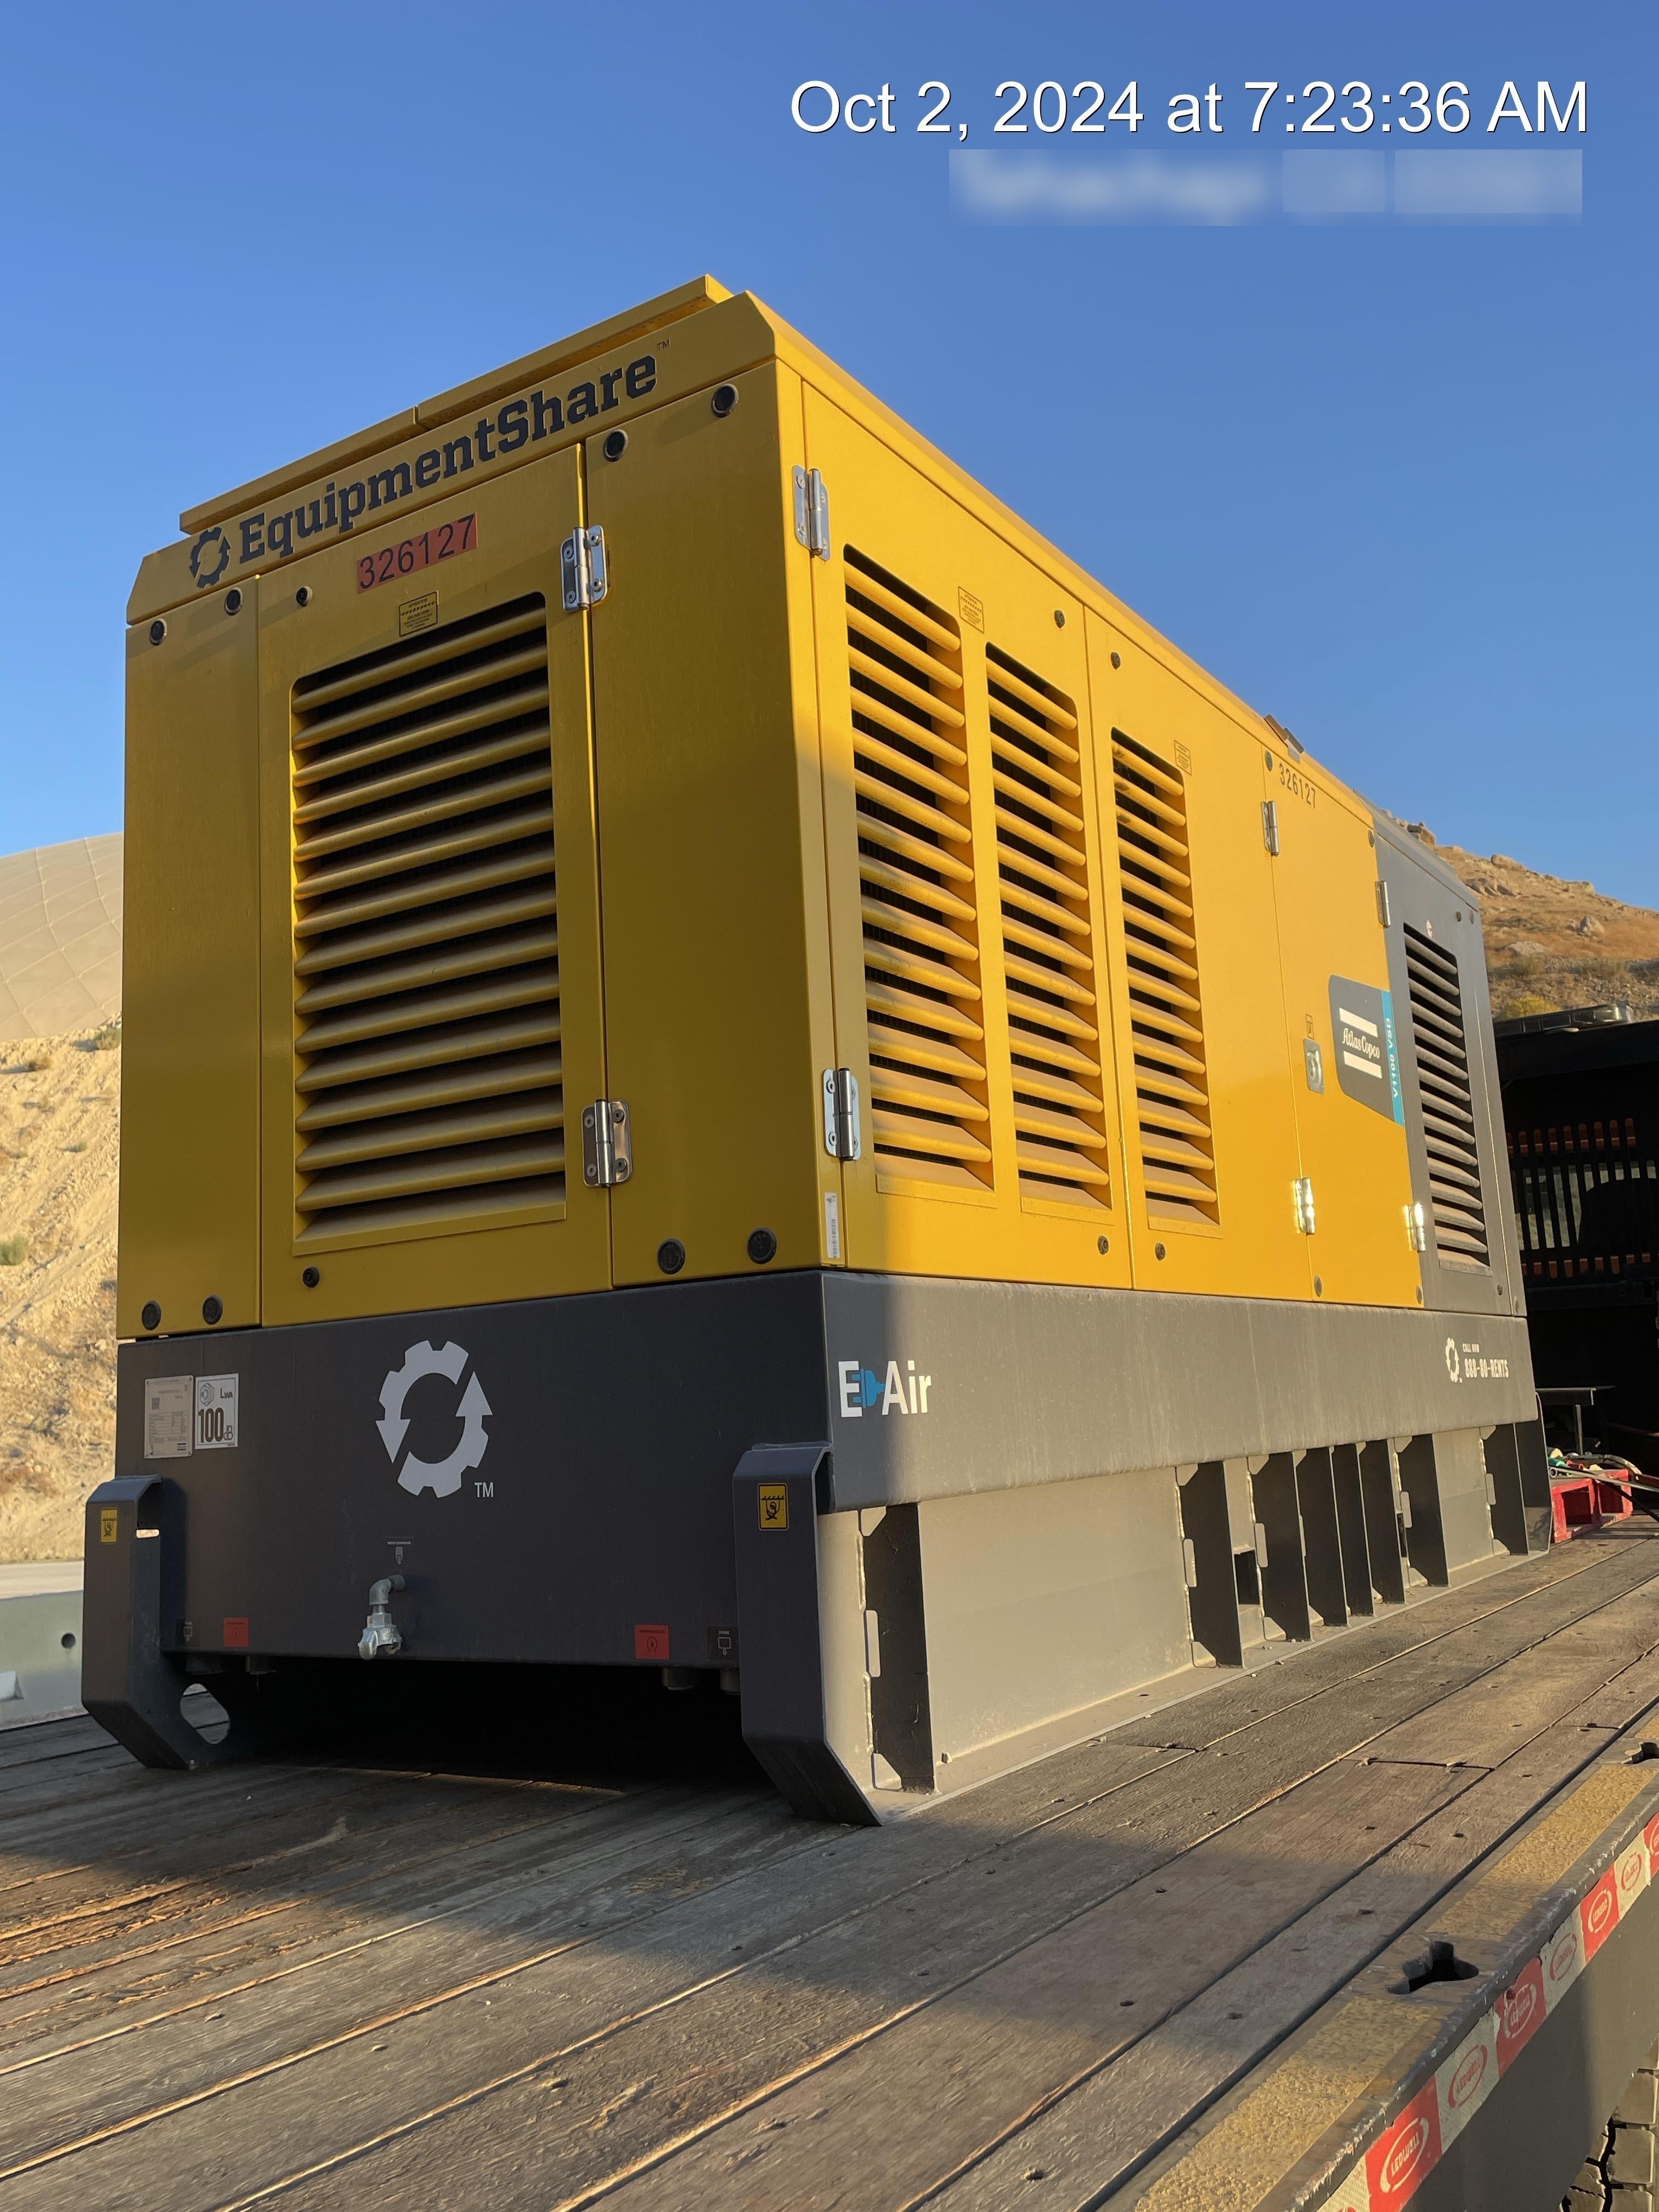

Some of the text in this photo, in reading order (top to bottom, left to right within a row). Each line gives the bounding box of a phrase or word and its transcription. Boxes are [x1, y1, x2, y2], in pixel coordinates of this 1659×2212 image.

[240, 354, 657, 565] EquipmentShare
[360, 513, 475, 589] 326127
[1279, 763, 1316, 809] 326127
[1342, 1027, 1380, 1059] Atlas Copco
[1389, 1054, 1398, 1098] V1100
[1464, 1358, 1509, 1378] 888-80-RENTS
[198, 1407, 224, 1443] 100
[223, 1425, 234, 1441] dB
[474, 1482, 494, 1498] TM
[1391, 2131, 1420, 2177] LEDWELL
